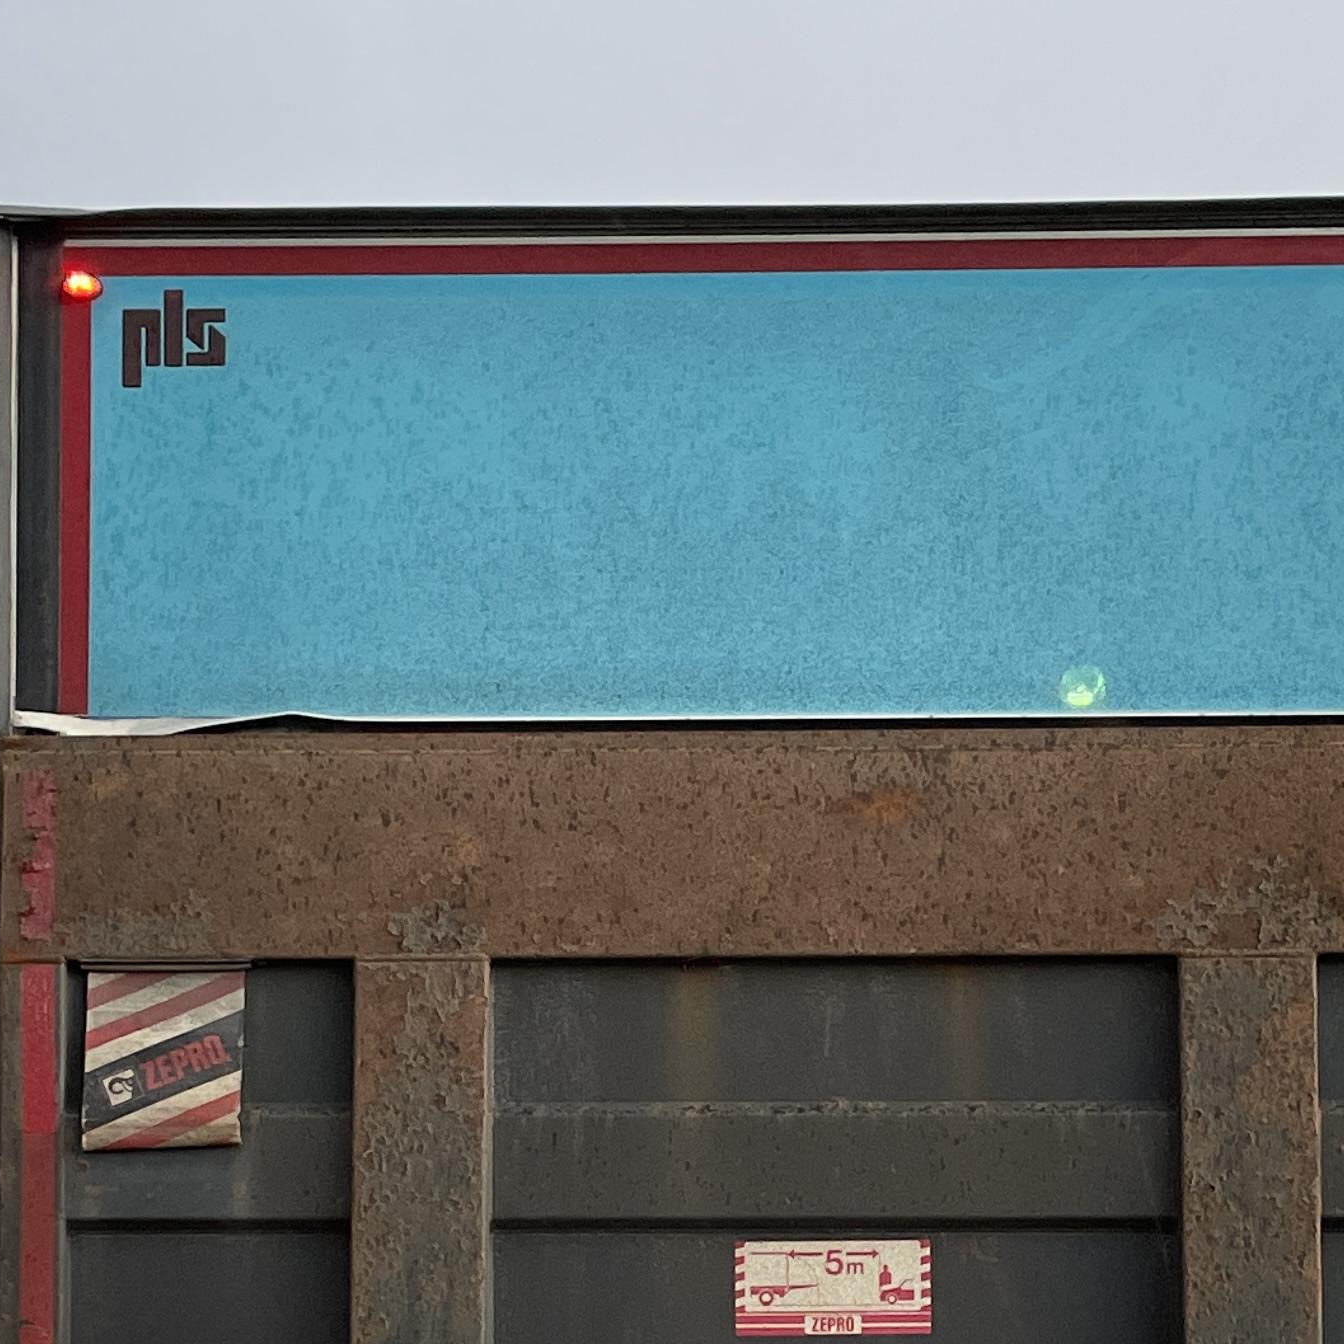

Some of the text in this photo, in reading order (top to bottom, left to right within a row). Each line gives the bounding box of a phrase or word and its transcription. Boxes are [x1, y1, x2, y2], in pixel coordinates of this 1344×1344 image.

[122, 289, 226, 388] pls
[139, 1033, 230, 1091] ZEPRO
[824, 1250, 864, 1276] 5 m
[812, 1317, 855, 1332] ZEPRO
